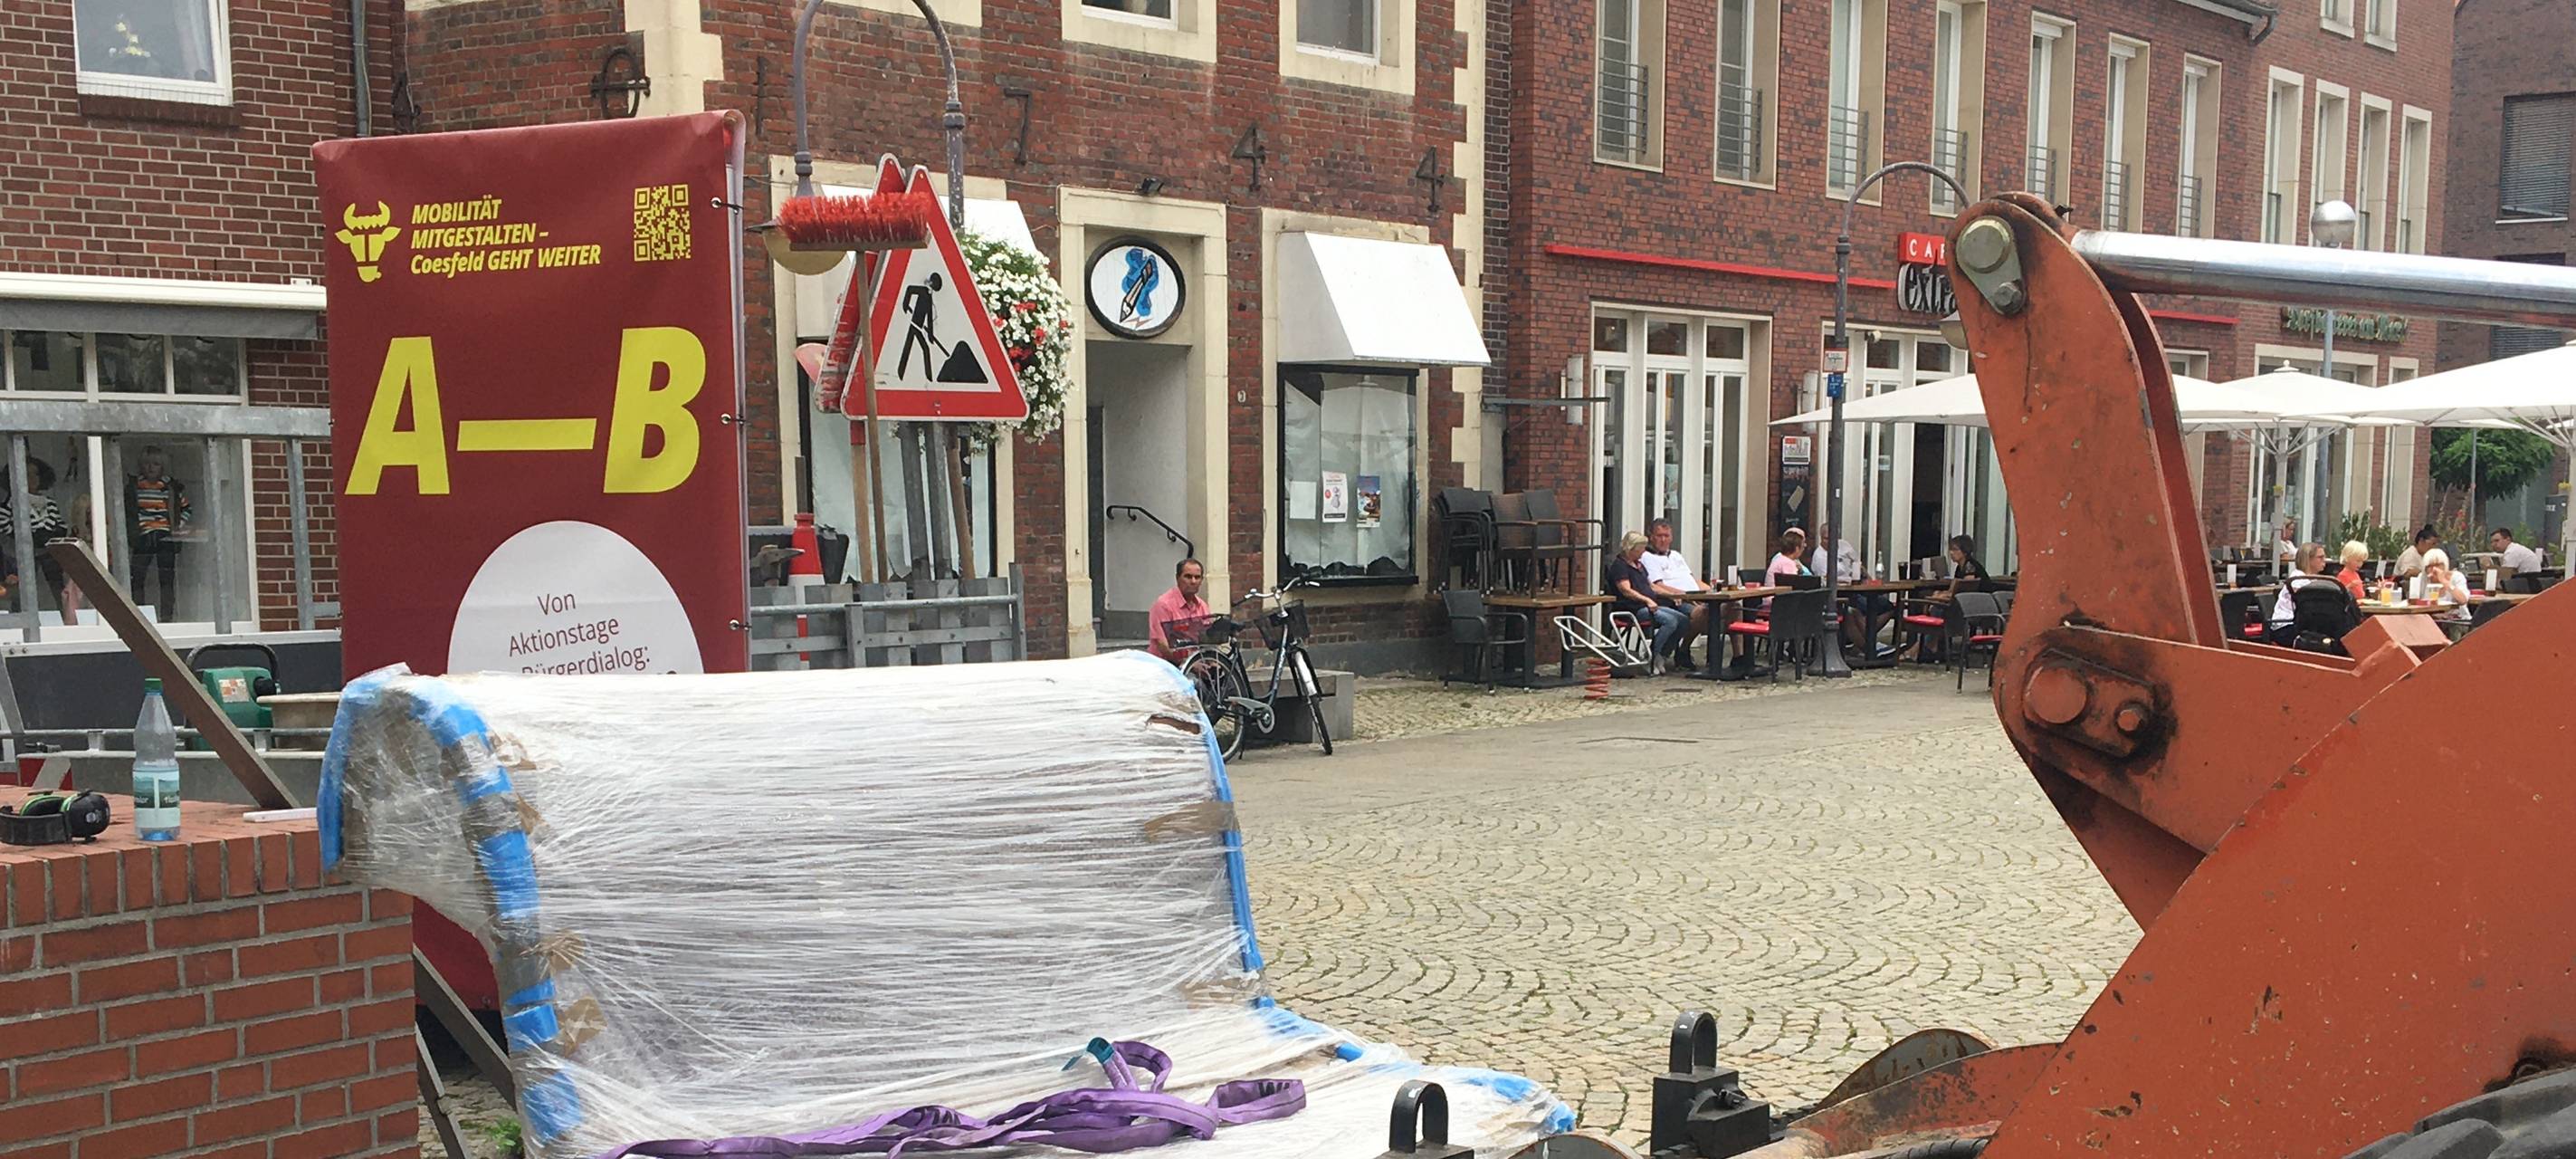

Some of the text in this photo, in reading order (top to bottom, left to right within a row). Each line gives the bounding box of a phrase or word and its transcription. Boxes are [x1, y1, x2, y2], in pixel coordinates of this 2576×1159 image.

[1231, 120, 1266, 192] 4
[1415, 145, 1445, 215] 4
[410, 194, 503, 225] MOBILITÄT
[409, 223, 538, 251] MITGESTALTEN
[410, 244, 603, 280] Coesfeld GEHT WEITER
[537, 593, 577, 616] Von
[509, 618, 618, 657] Aktionstage
